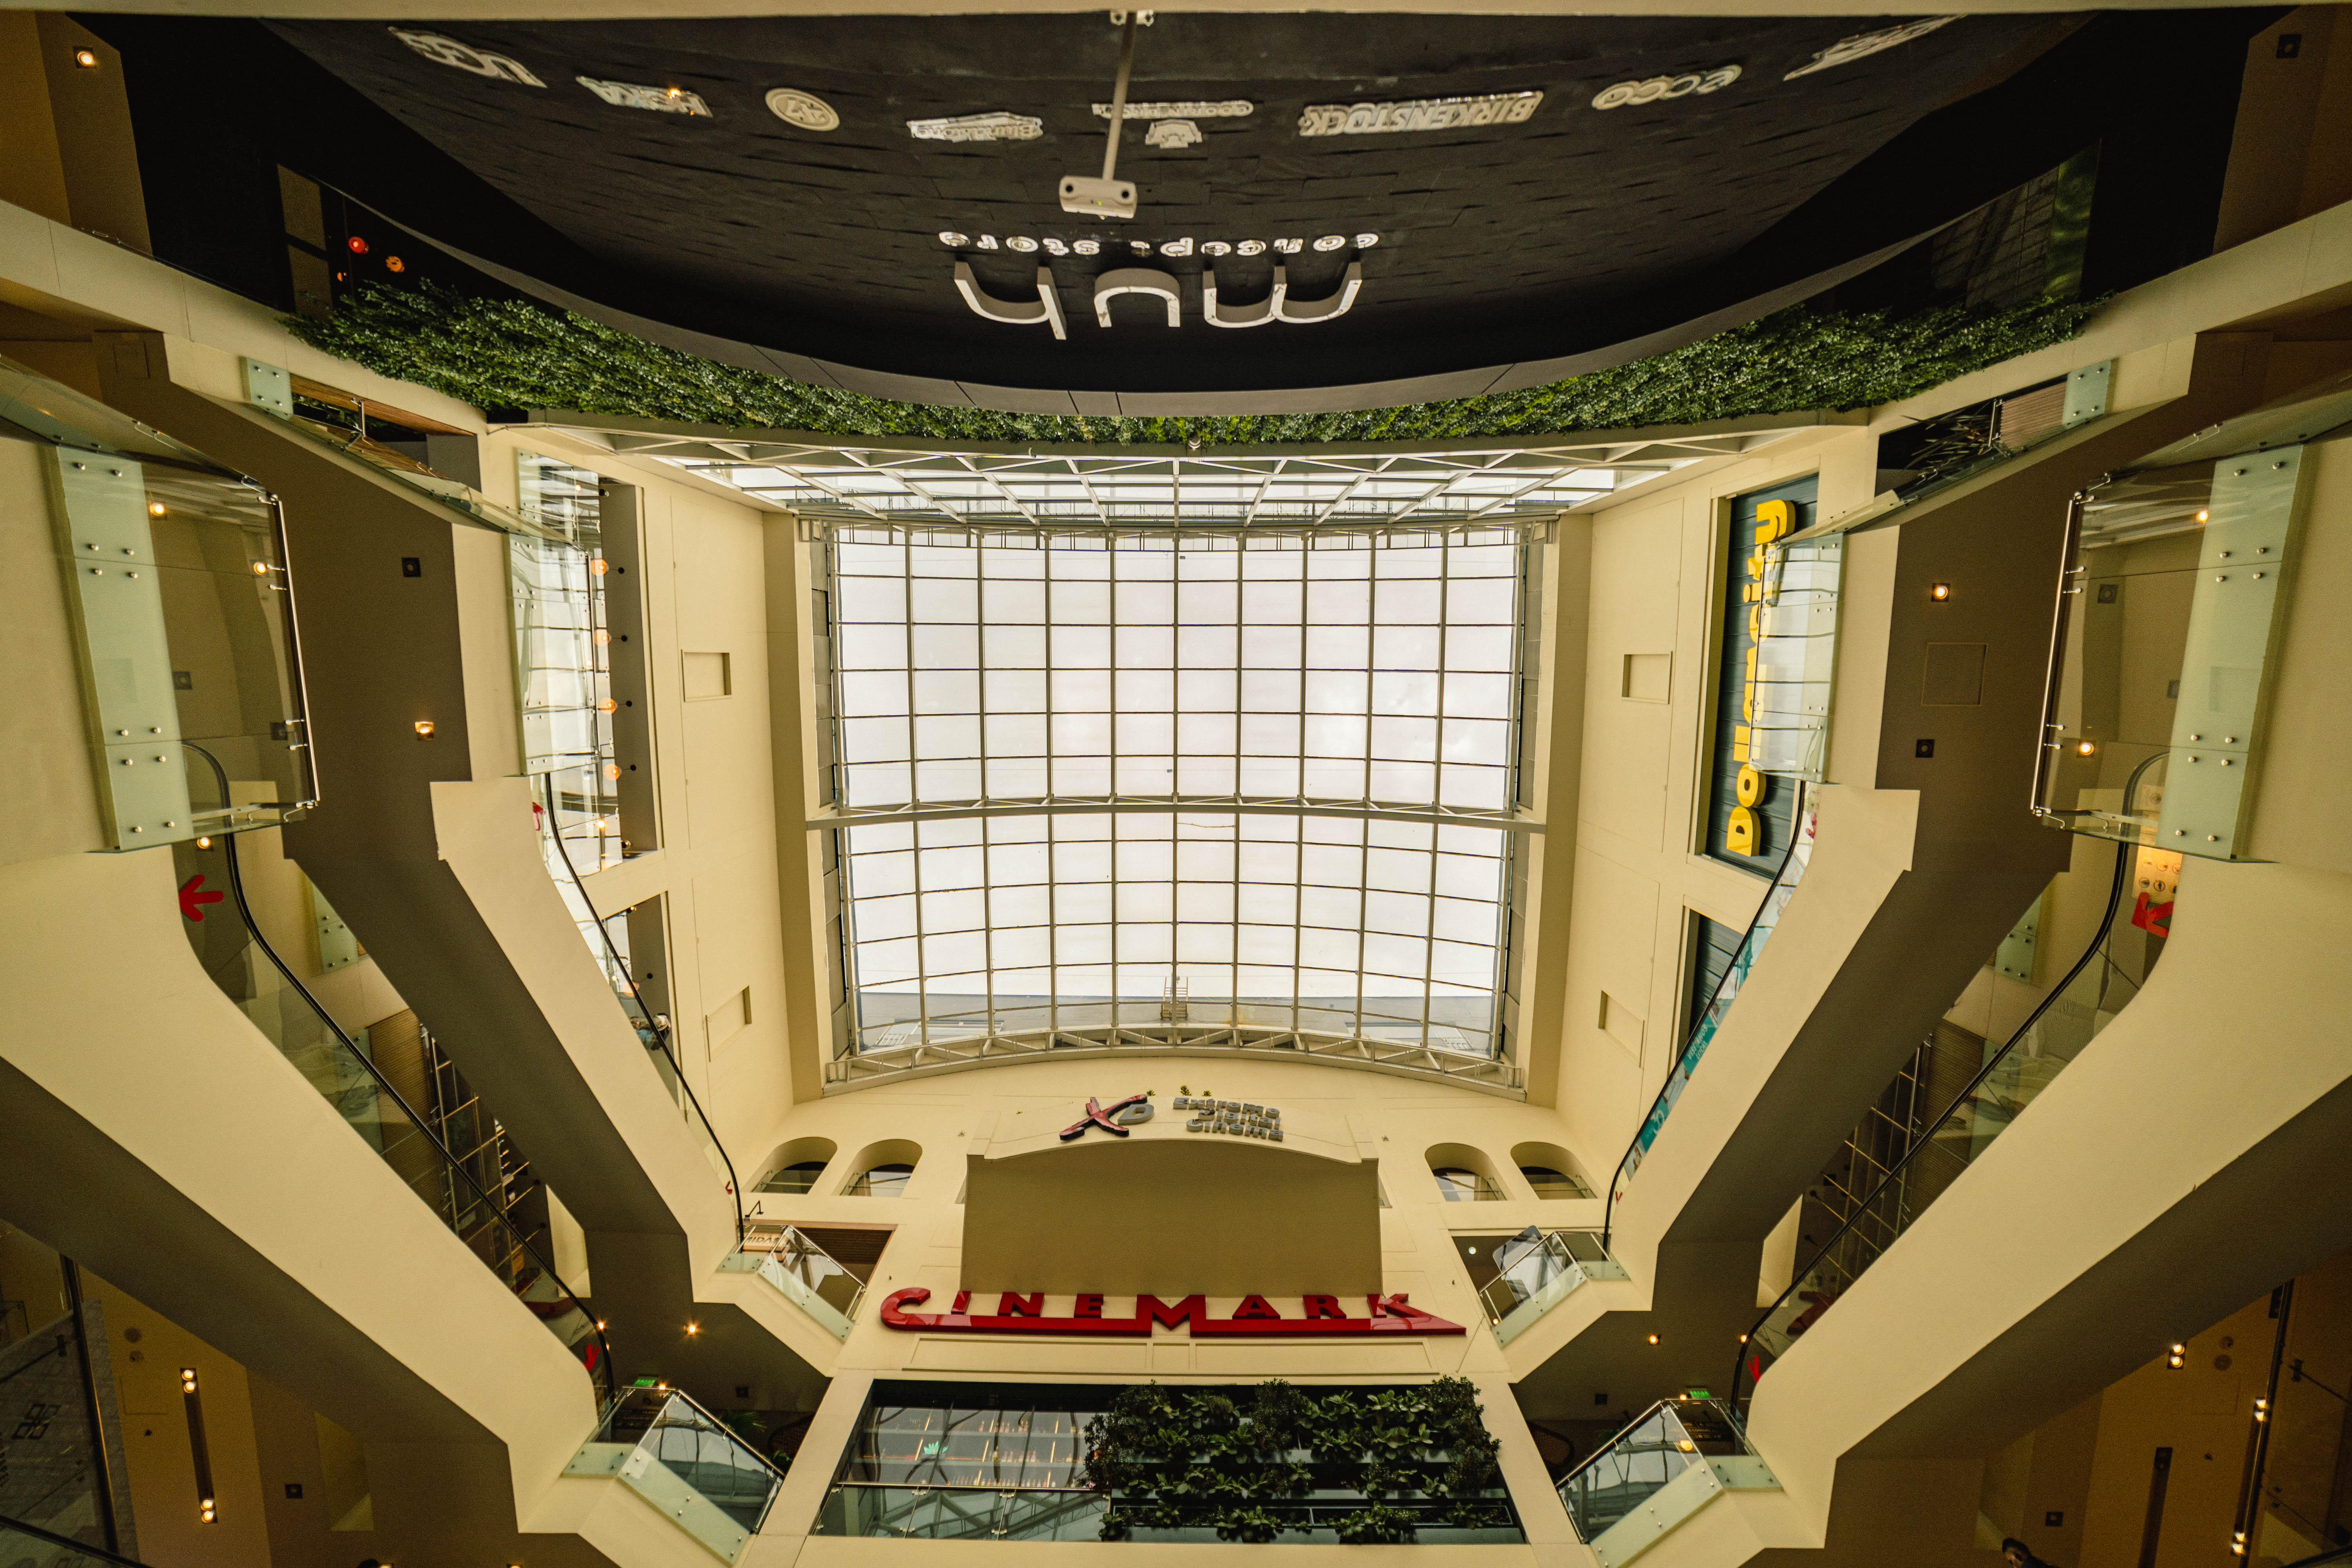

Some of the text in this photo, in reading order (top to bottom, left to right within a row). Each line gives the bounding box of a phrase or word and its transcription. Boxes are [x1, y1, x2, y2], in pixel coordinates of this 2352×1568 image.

[387, 26, 547, 88] UGG
[575, 76, 713, 118] HOKA
[1594, 67, 1740, 110] ecco
[1301, 93, 1541, 136] BIRKENSTOCK
[939, 231, 1379, 258] concept store
[954, 261, 1363, 340] muh
[1726, 499, 1797, 857] Dollarcity
[1060, 1094, 1154, 1141] XD
[1173, 1097, 1280, 1119] Extreme
[1198, 1107, 1281, 1130] Digital
[1186, 1118, 1284, 1142] Cinema
[880, 1287, 1467, 1338] CINEMARK
